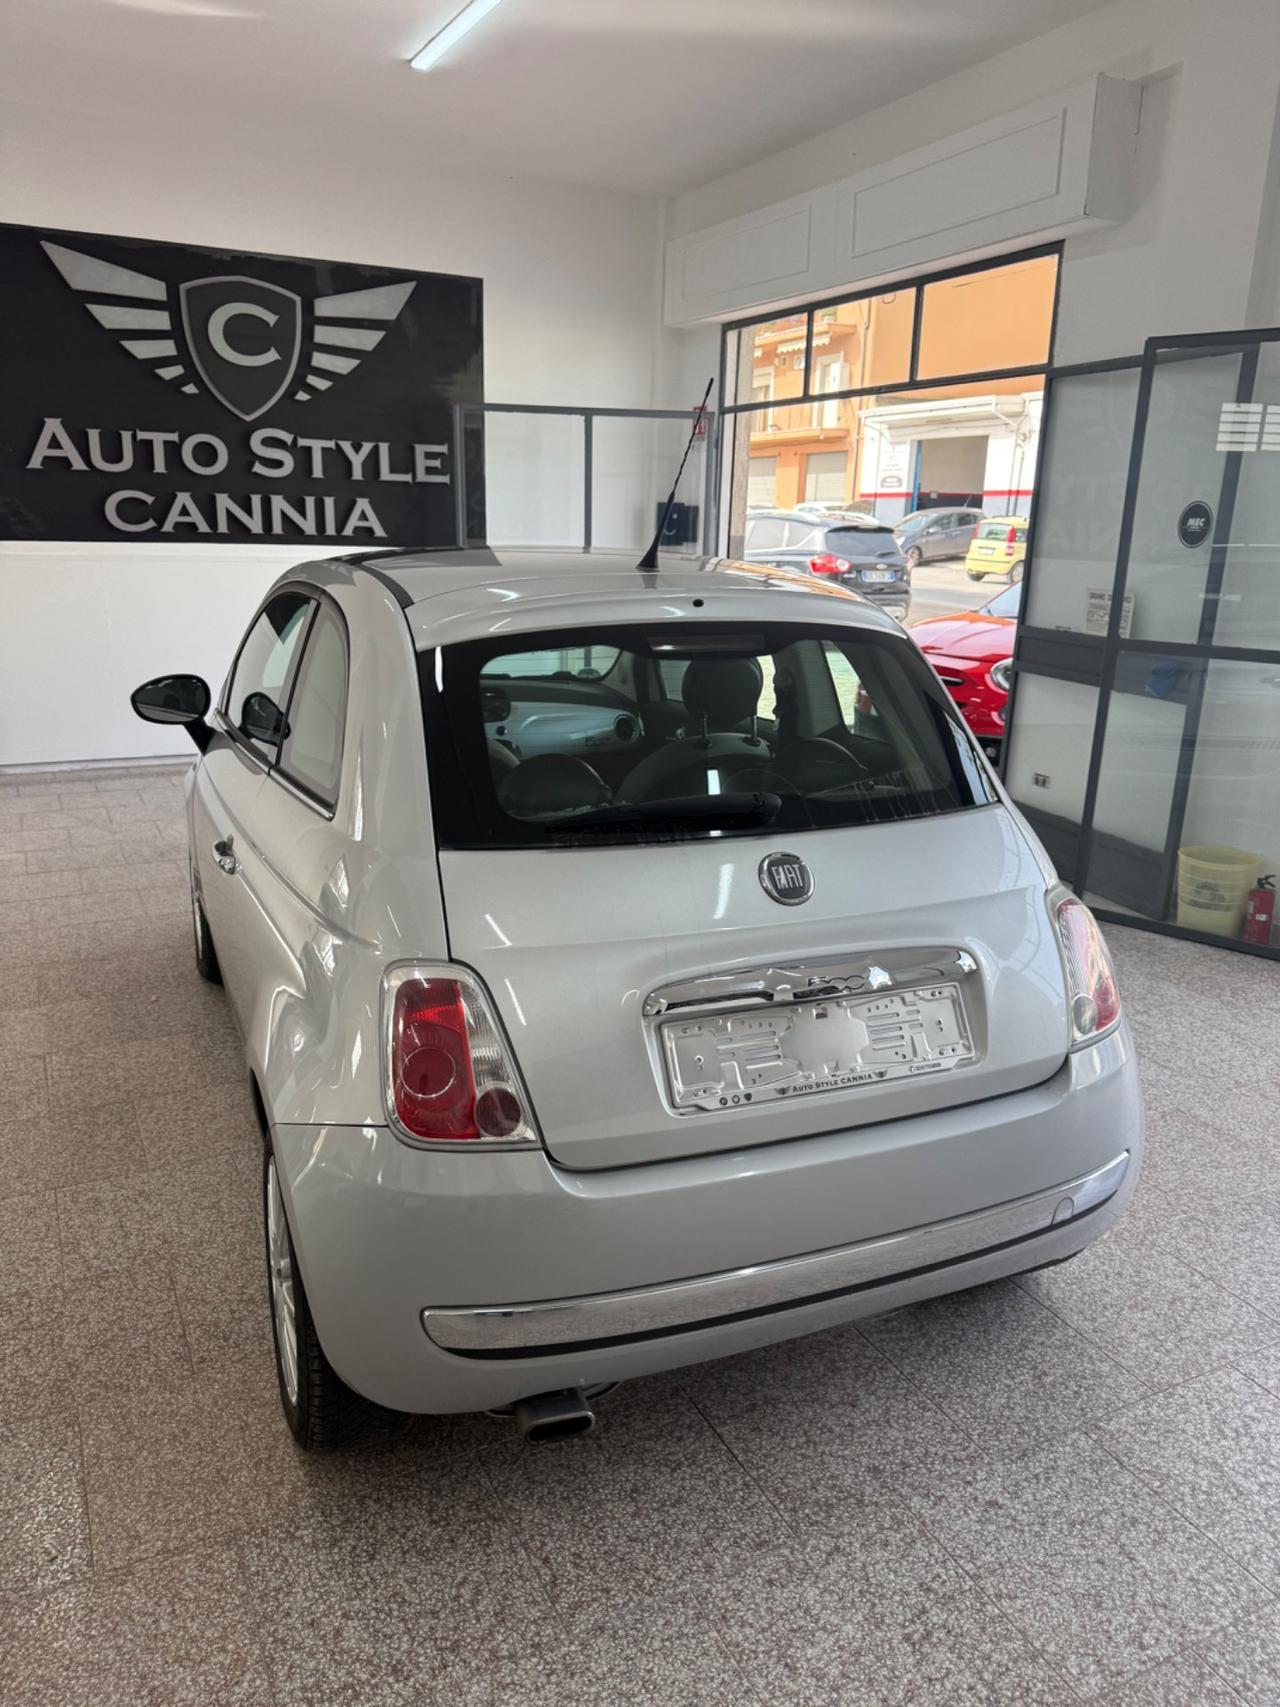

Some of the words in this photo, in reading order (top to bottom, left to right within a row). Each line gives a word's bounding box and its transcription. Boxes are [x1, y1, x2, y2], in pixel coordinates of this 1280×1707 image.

[207, 302, 282, 367] C
[25, 417, 229, 476] AUTO
[249, 427, 451, 484] STYLE
[104, 489, 388, 538] CANNIA
[771, 864, 803, 889] FIAT
[792, 1083, 814, 1093] AUTO
[815, 1079, 839, 1089] STYLE
[840, 1073, 873, 1084] CANNIA
